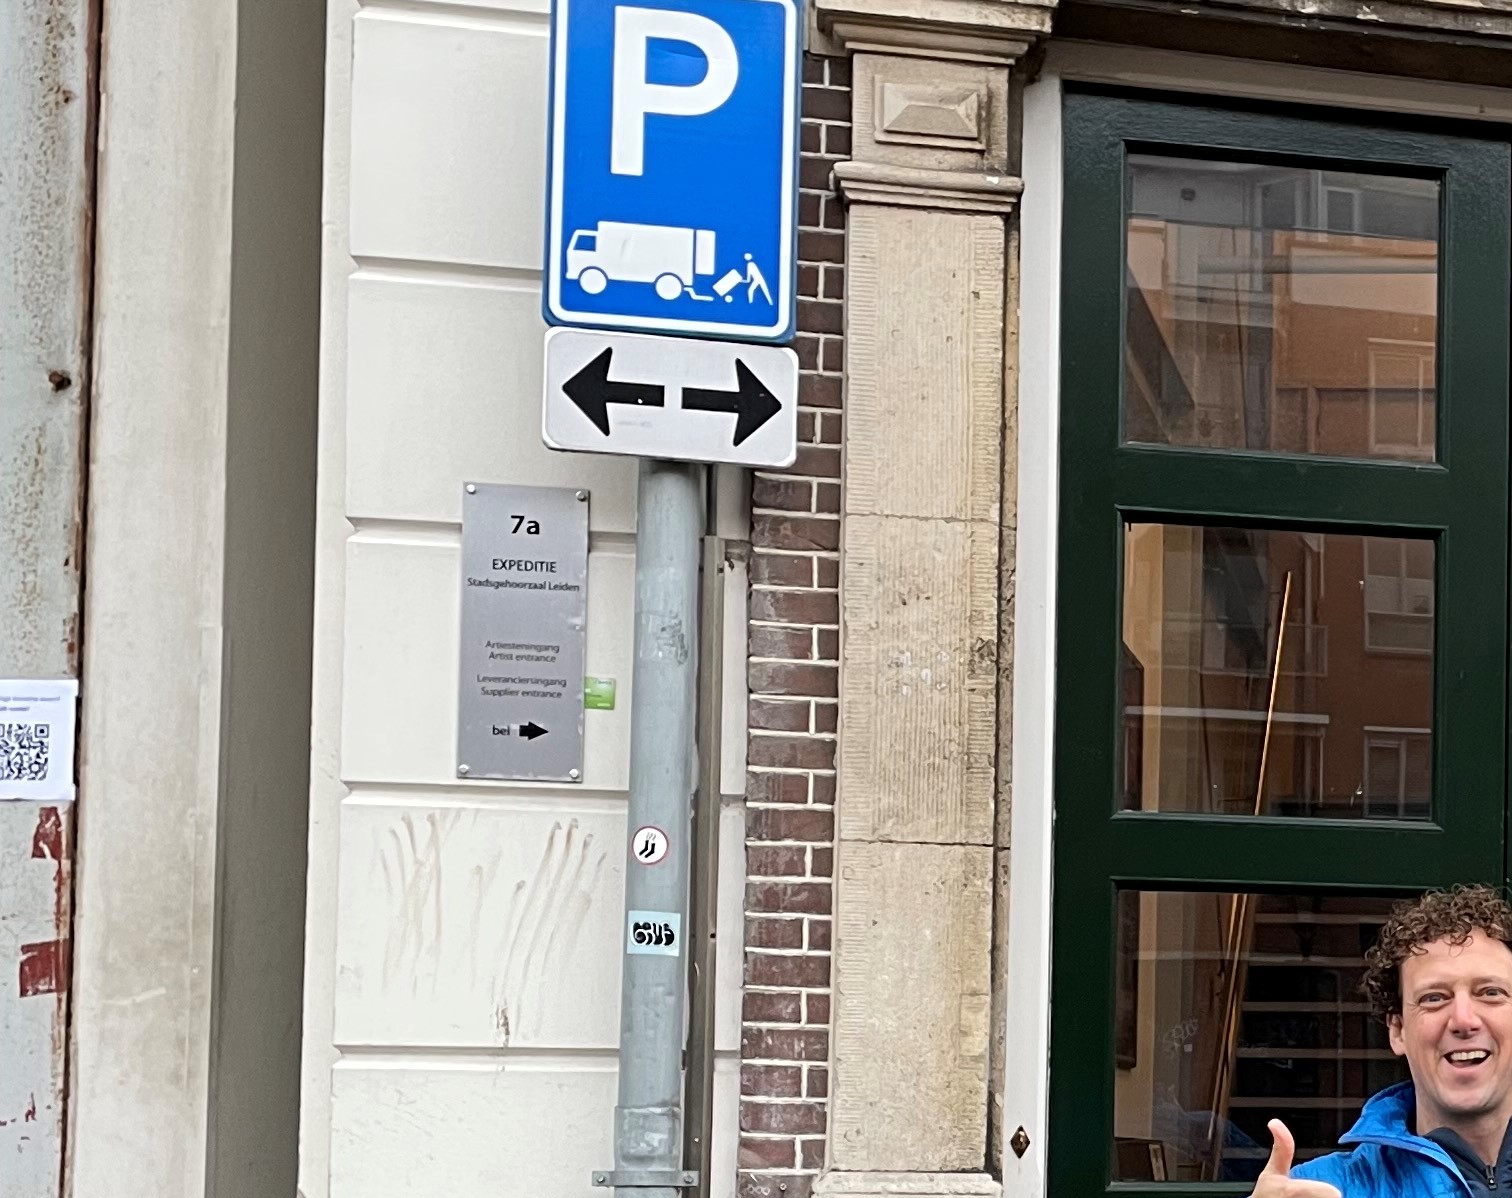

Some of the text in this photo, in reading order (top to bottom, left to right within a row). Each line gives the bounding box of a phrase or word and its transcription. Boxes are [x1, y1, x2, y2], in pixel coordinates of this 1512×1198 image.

[610, 5, 739, 177] P
[510, 515, 540, 535] 7a
[492, 558, 557, 573] EXPEDITIE
[467, 577, 580, 592] Stadsgehoorzaal Leiden
[489, 651, 557, 663] Artist entrance
[481, 686, 562, 698] Supplier entrance
